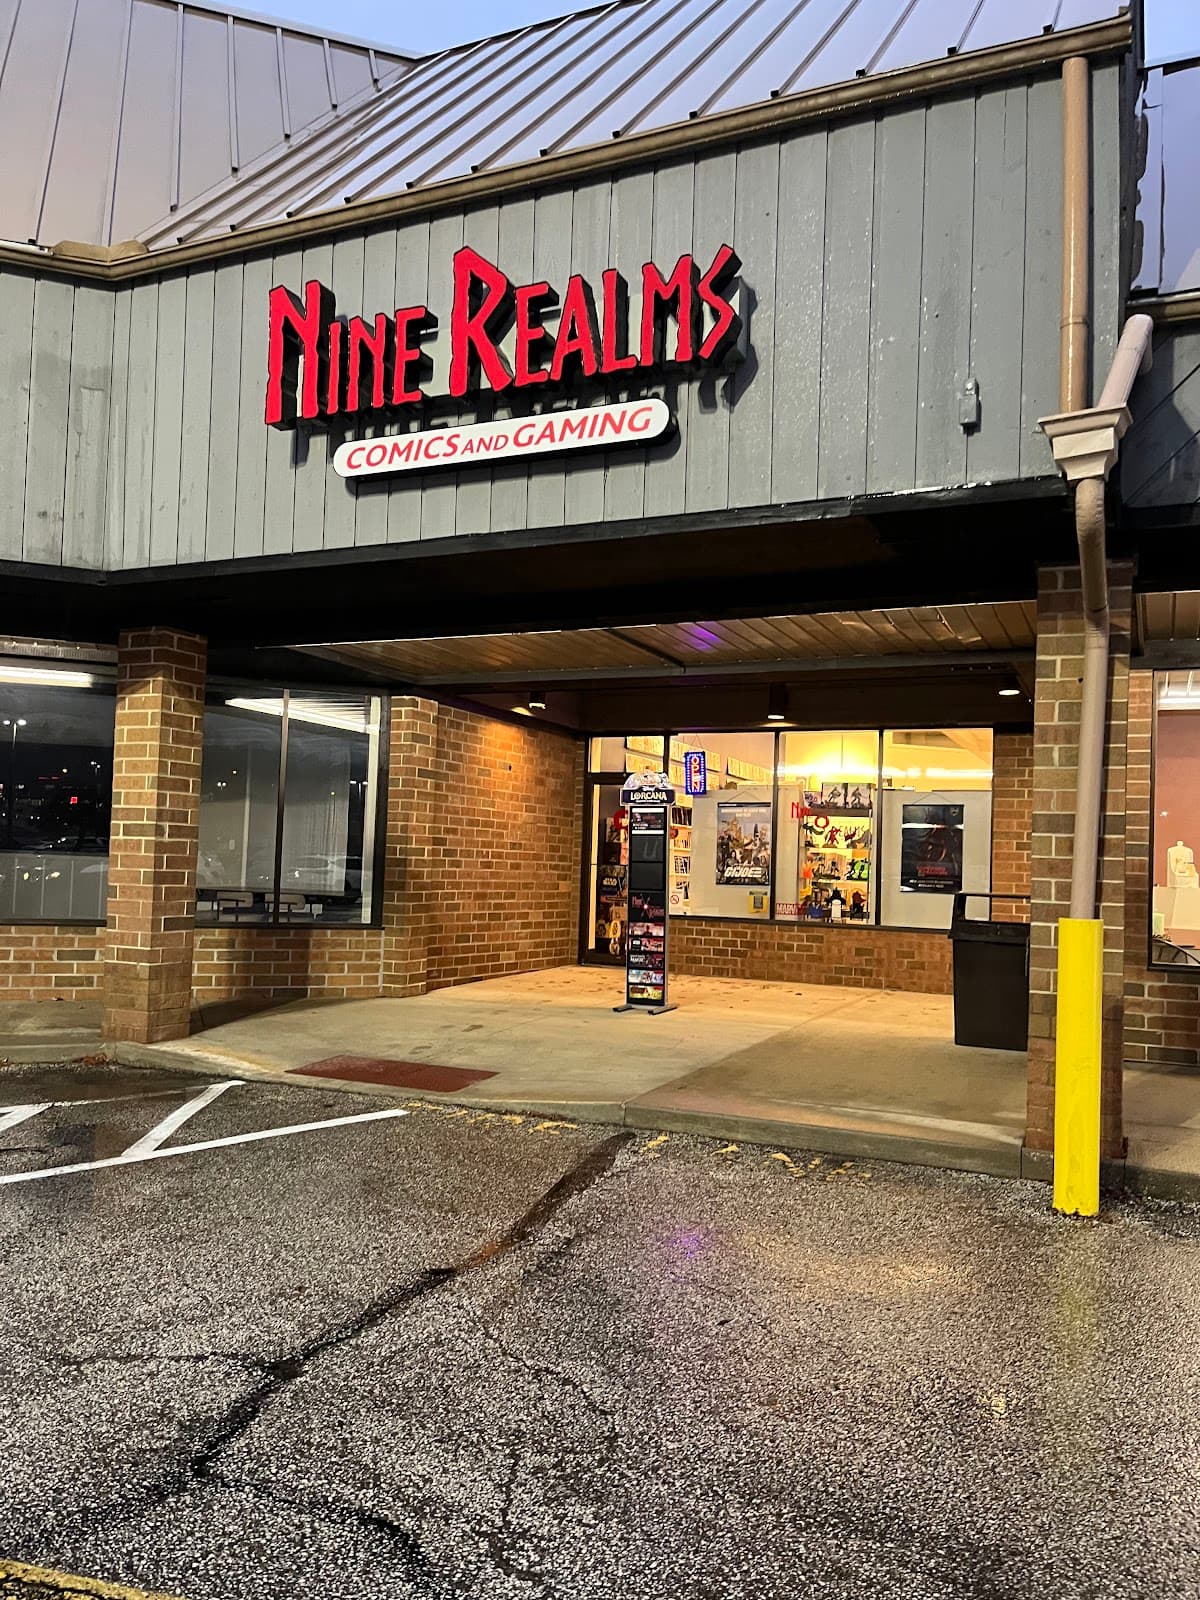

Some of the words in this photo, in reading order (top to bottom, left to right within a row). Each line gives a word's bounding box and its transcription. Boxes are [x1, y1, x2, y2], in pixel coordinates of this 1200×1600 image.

[265, 279, 425, 425] NINE
[449, 245, 735, 397] REALMS
[346, 433, 461, 470] COMICS
[461, 434, 508, 456] AND
[513, 406, 653, 448] GAMING
[630, 791, 668, 801] LORCANA
[691, 756, 700, 793] OPEN
